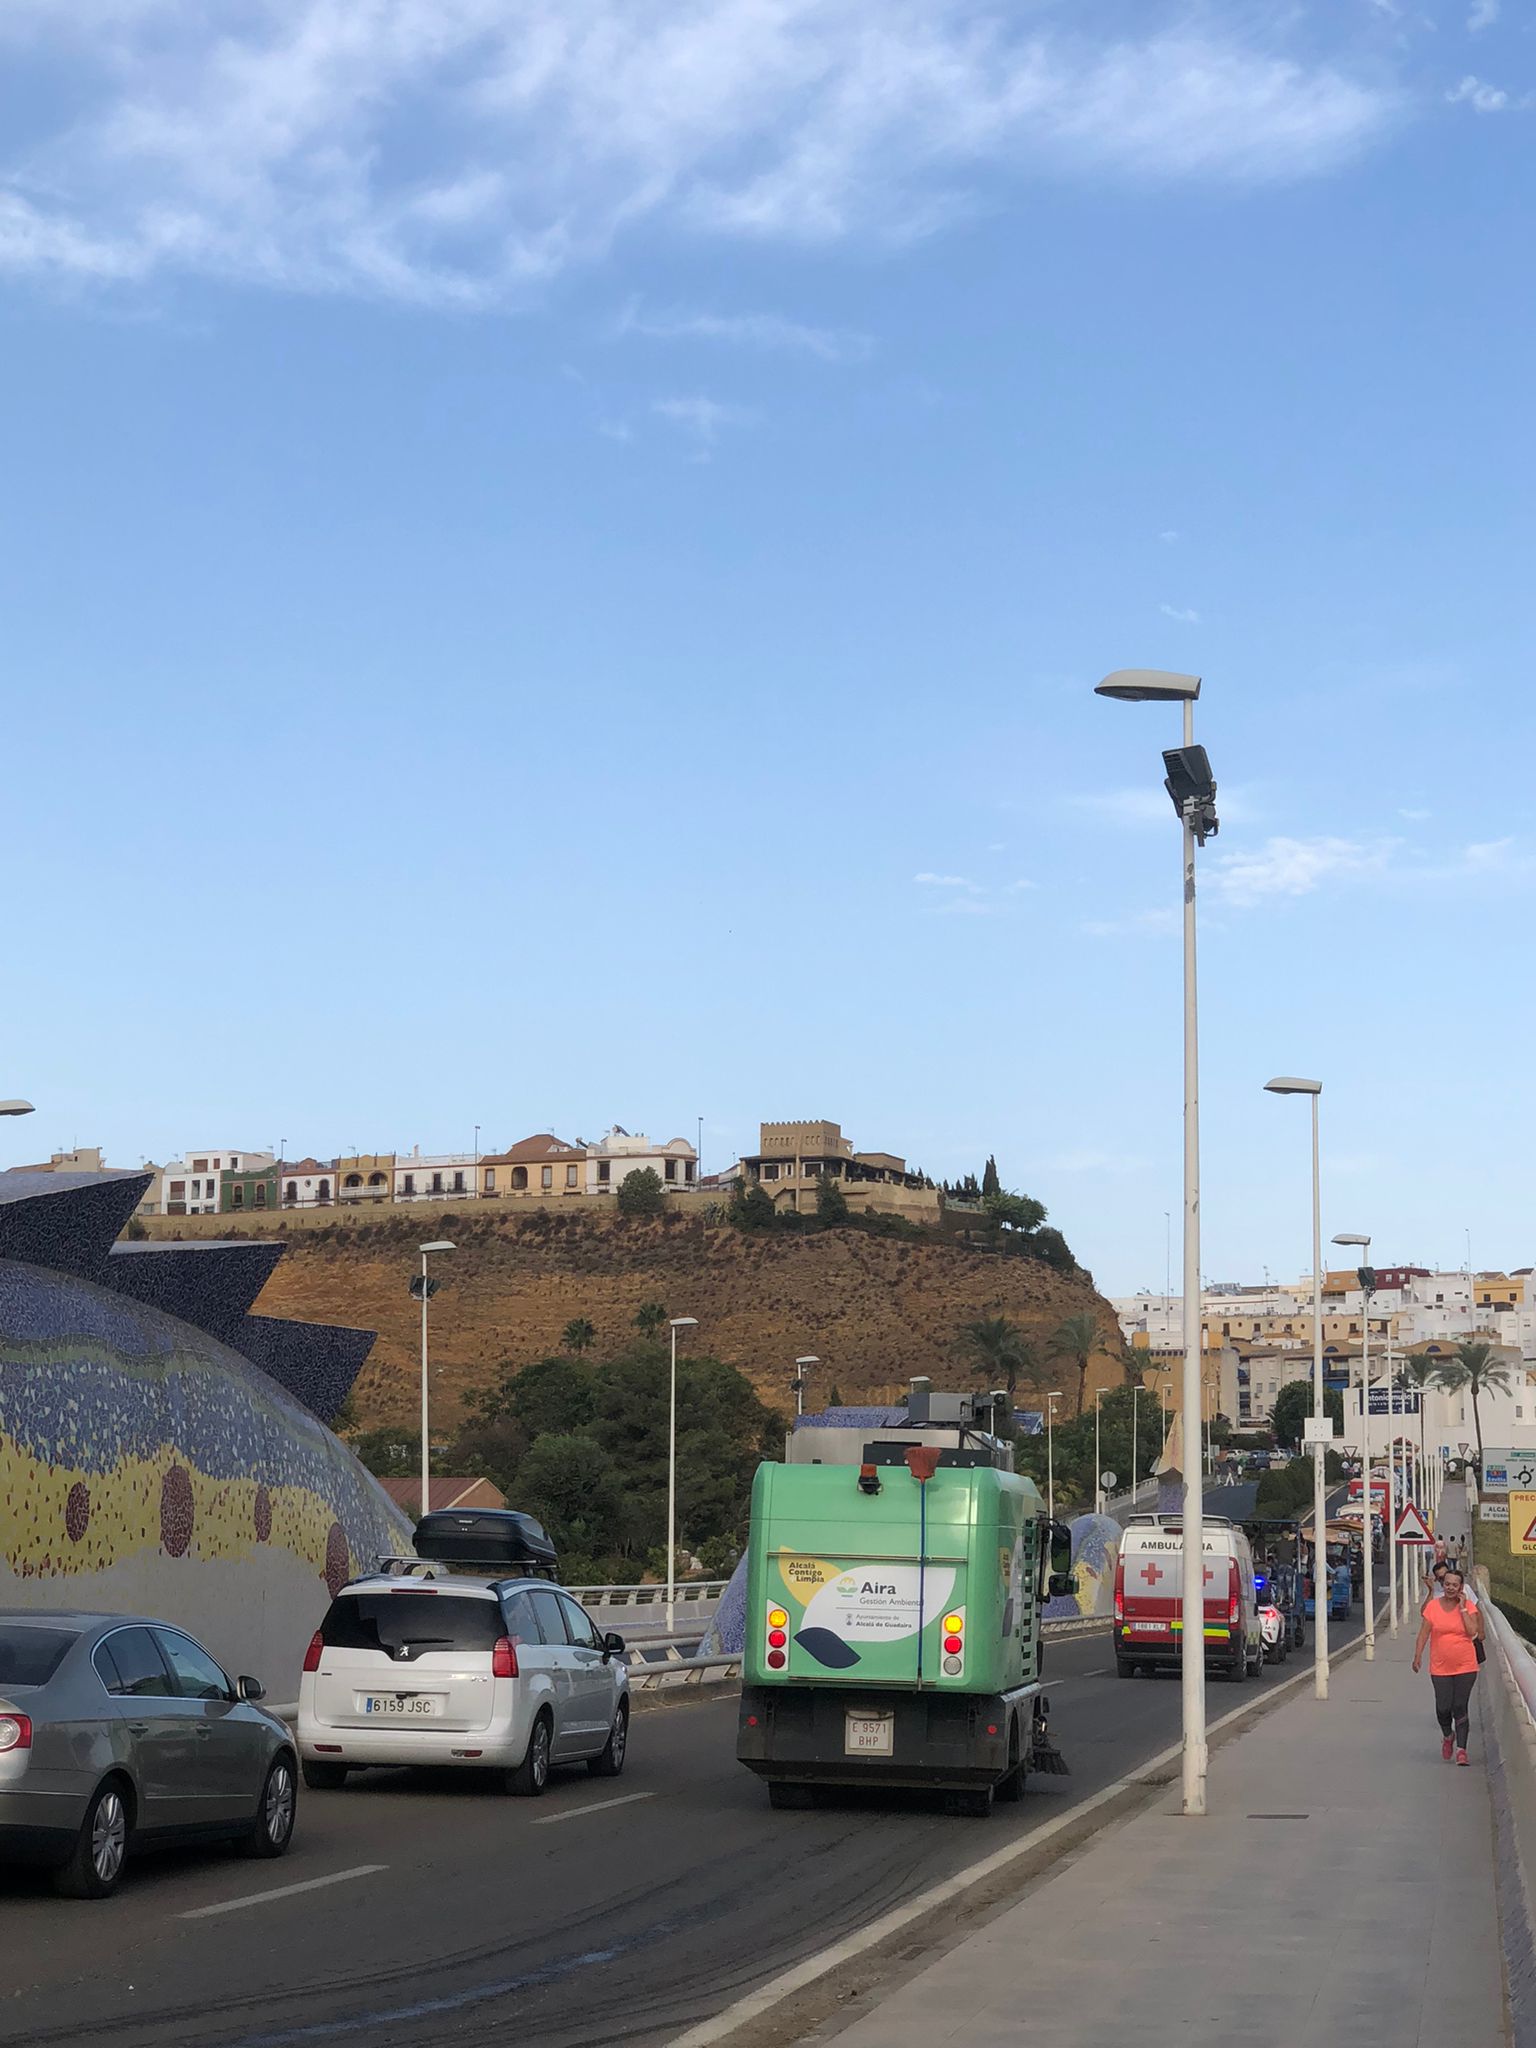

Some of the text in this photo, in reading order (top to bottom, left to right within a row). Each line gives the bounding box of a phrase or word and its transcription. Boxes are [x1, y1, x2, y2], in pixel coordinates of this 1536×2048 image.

[1140, 1541, 1213, 1551] AMBULAIA
[788, 1569, 823, 1577] Contigo
[796, 1576, 825, 1584] Limpia
[861, 1582, 896, 1594] Aira
[859, 1597, 887, 1605] Gestión
[373, 1700, 431, 1713] 6159 JSC
[852, 1722, 887, 1734] E 9571
[858, 1736, 879, 1746] BHP
